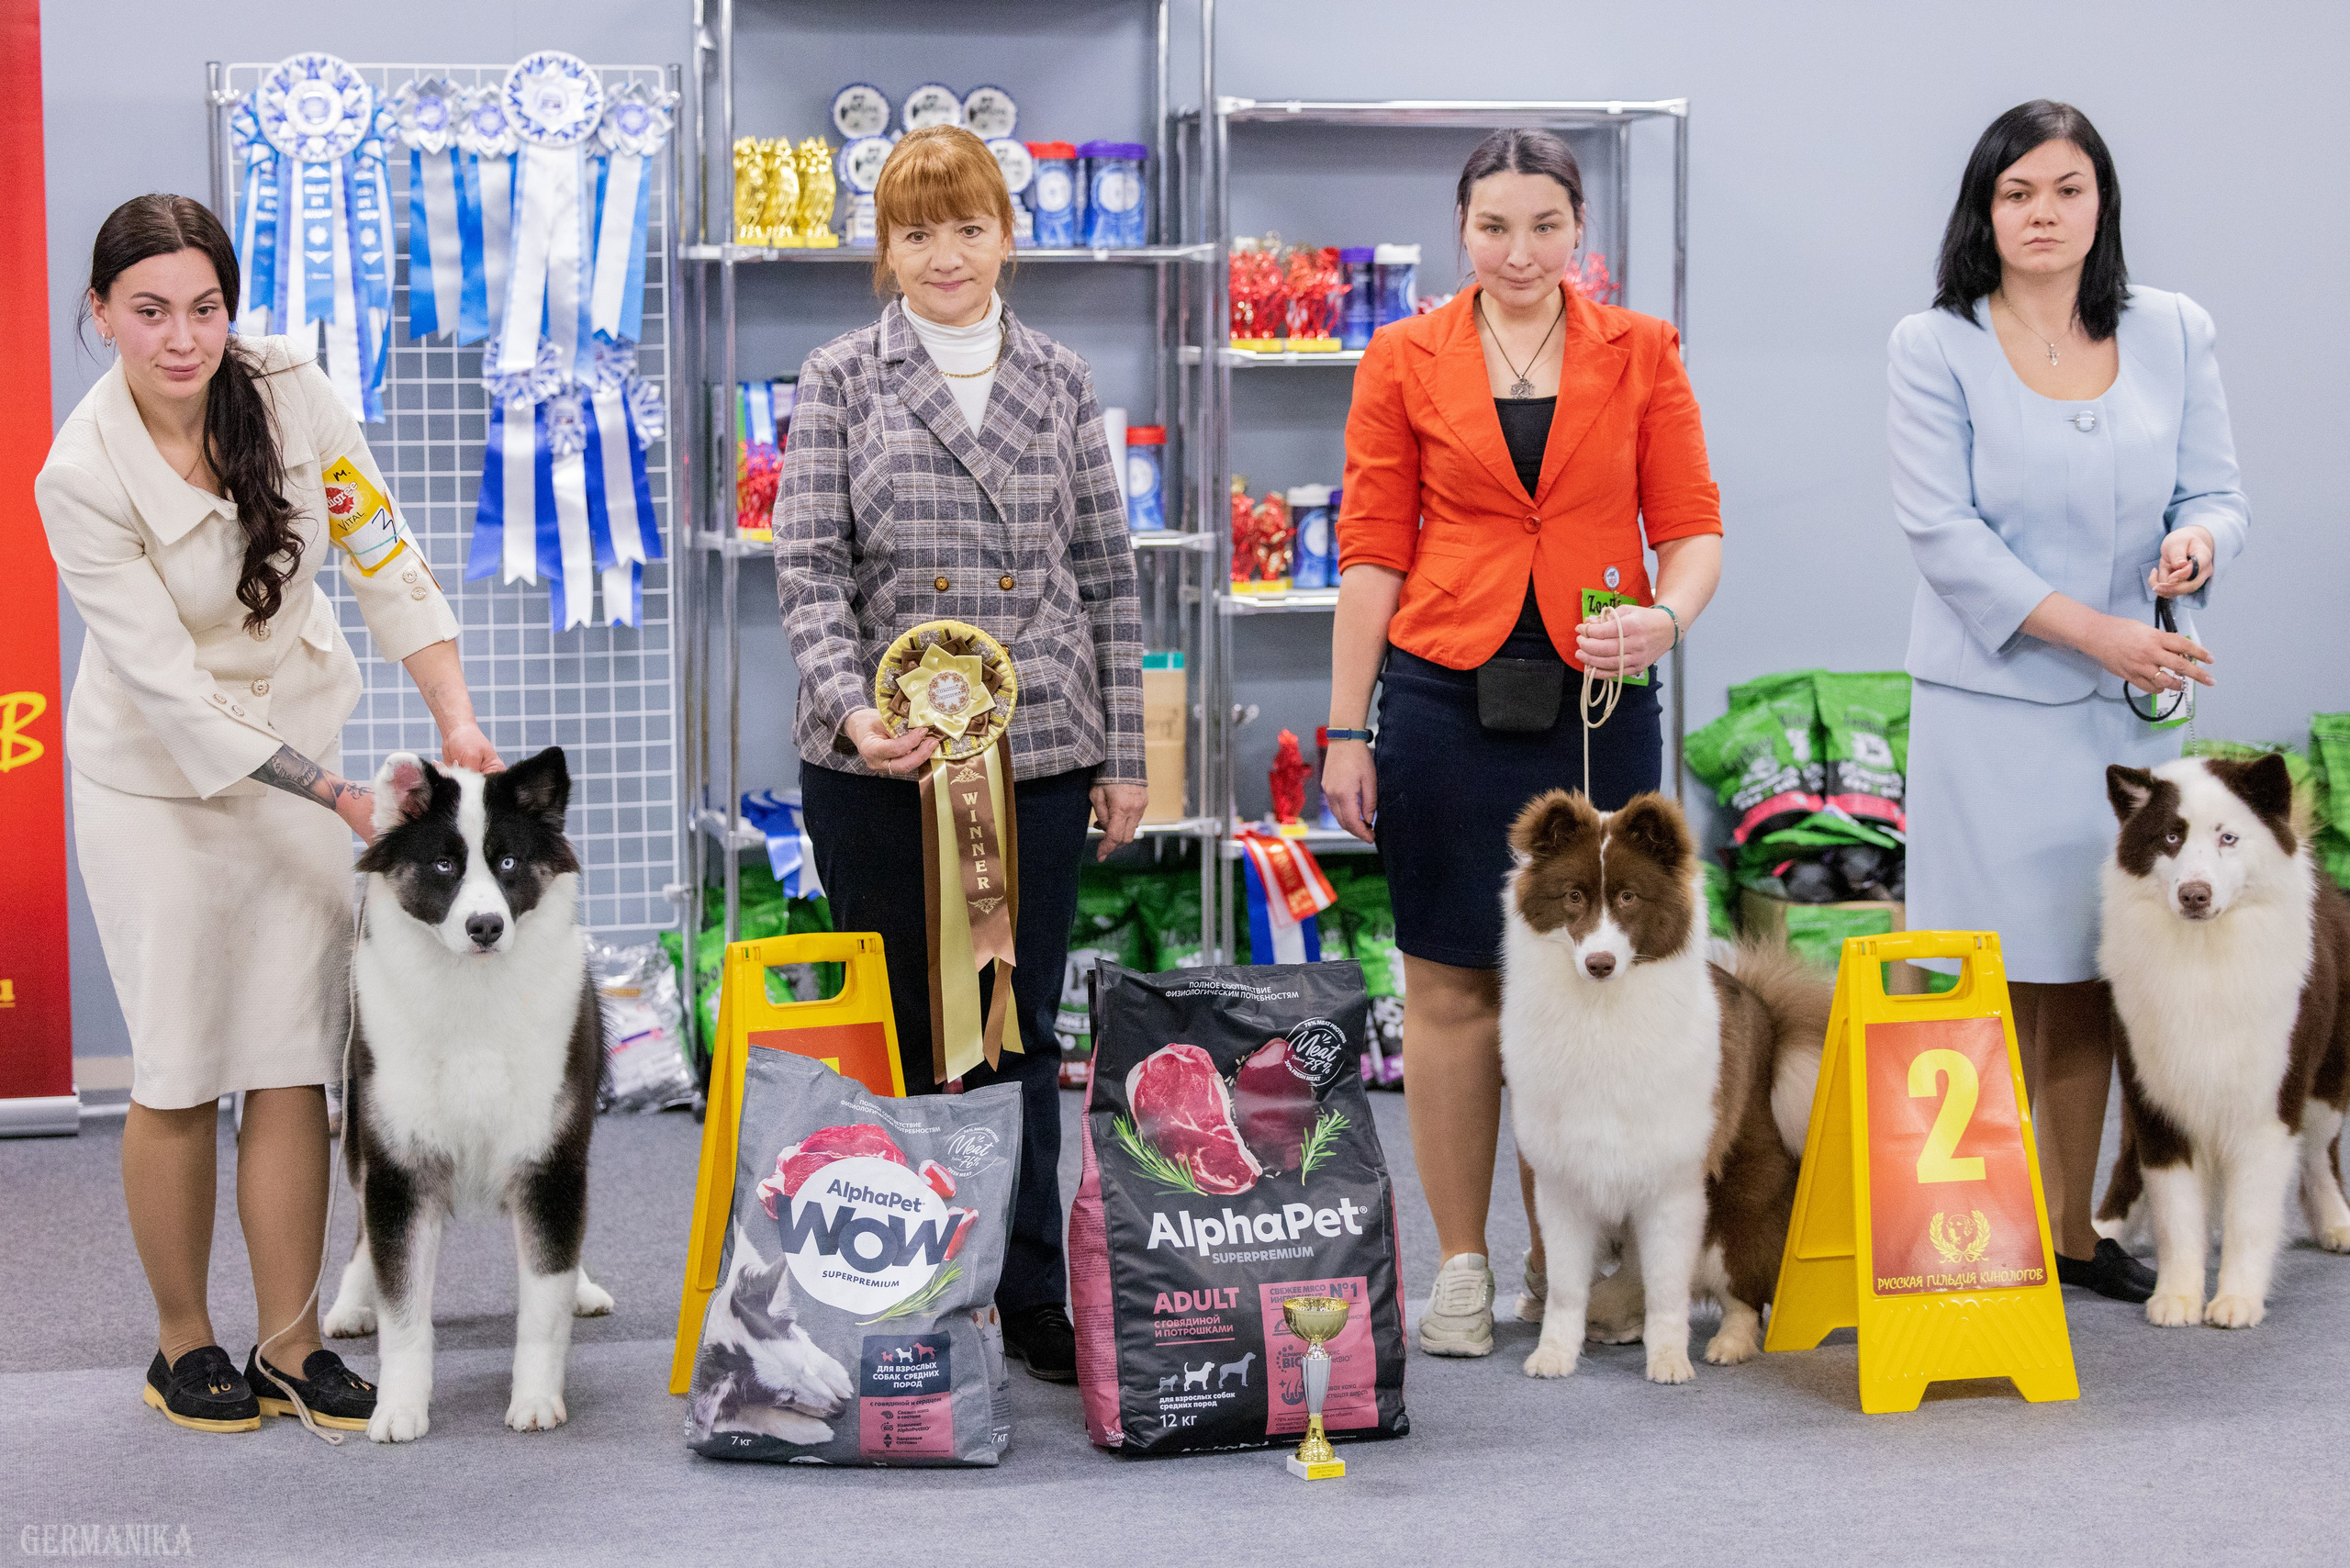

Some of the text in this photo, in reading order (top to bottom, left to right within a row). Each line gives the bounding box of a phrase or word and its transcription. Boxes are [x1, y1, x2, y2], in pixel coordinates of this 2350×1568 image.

[338, 510, 365, 532] VITAL
[962, 791, 990, 890] WINNER
[1165, 989, 1300, 1002] ФИЗИОЛОГИЧЕСКИМ ПОТРЕБНОСТЯМ
[1221, 983, 1272, 994] СООТВЕТСТВИЕ
[1287, 1030, 1342, 1062] Meat
[1304, 1057, 1332, 1074] 78%
[1908, 1048, 1986, 1184] 2
[948, 1135, 994, 1157] Meat
[959, 1156, 981, 1169] 76%
[777, 1193, 964, 1273] WOW
[1212, 1246, 1315, 1264] SUPERPREMIUM
[822, 1271, 900, 1288] SUPERPREMIUM
[1877, 1268, 2043, 1291] РУССКАЯ ГИЛЬДИЯ КИНОЛОГОВ
[1270, 1286, 1302, 1295] СВЕЖЕЕ
[1303, 1284, 1326, 1293] МЯСО
[1153, 1287, 1240, 1315] ADULT
[1154, 1314, 1221, 1328] С ГОВЯДИНОЙ
[1163, 1325, 1234, 1338] ПОТРОШКАМИ
[877, 1362, 937, 1373] ДЛЯ ВЗРОСЛЫХ
[904, 1371, 939, 1381] СРЕДНИХ
[1175, 1394, 1212, 1403] взрослых
[1159, 1401, 1217, 1411] средних пород
[1160, 1414, 1178, 1428] 12
[731, 1436, 739, 1445] 7
[991, 1433, 998, 1443] 7
